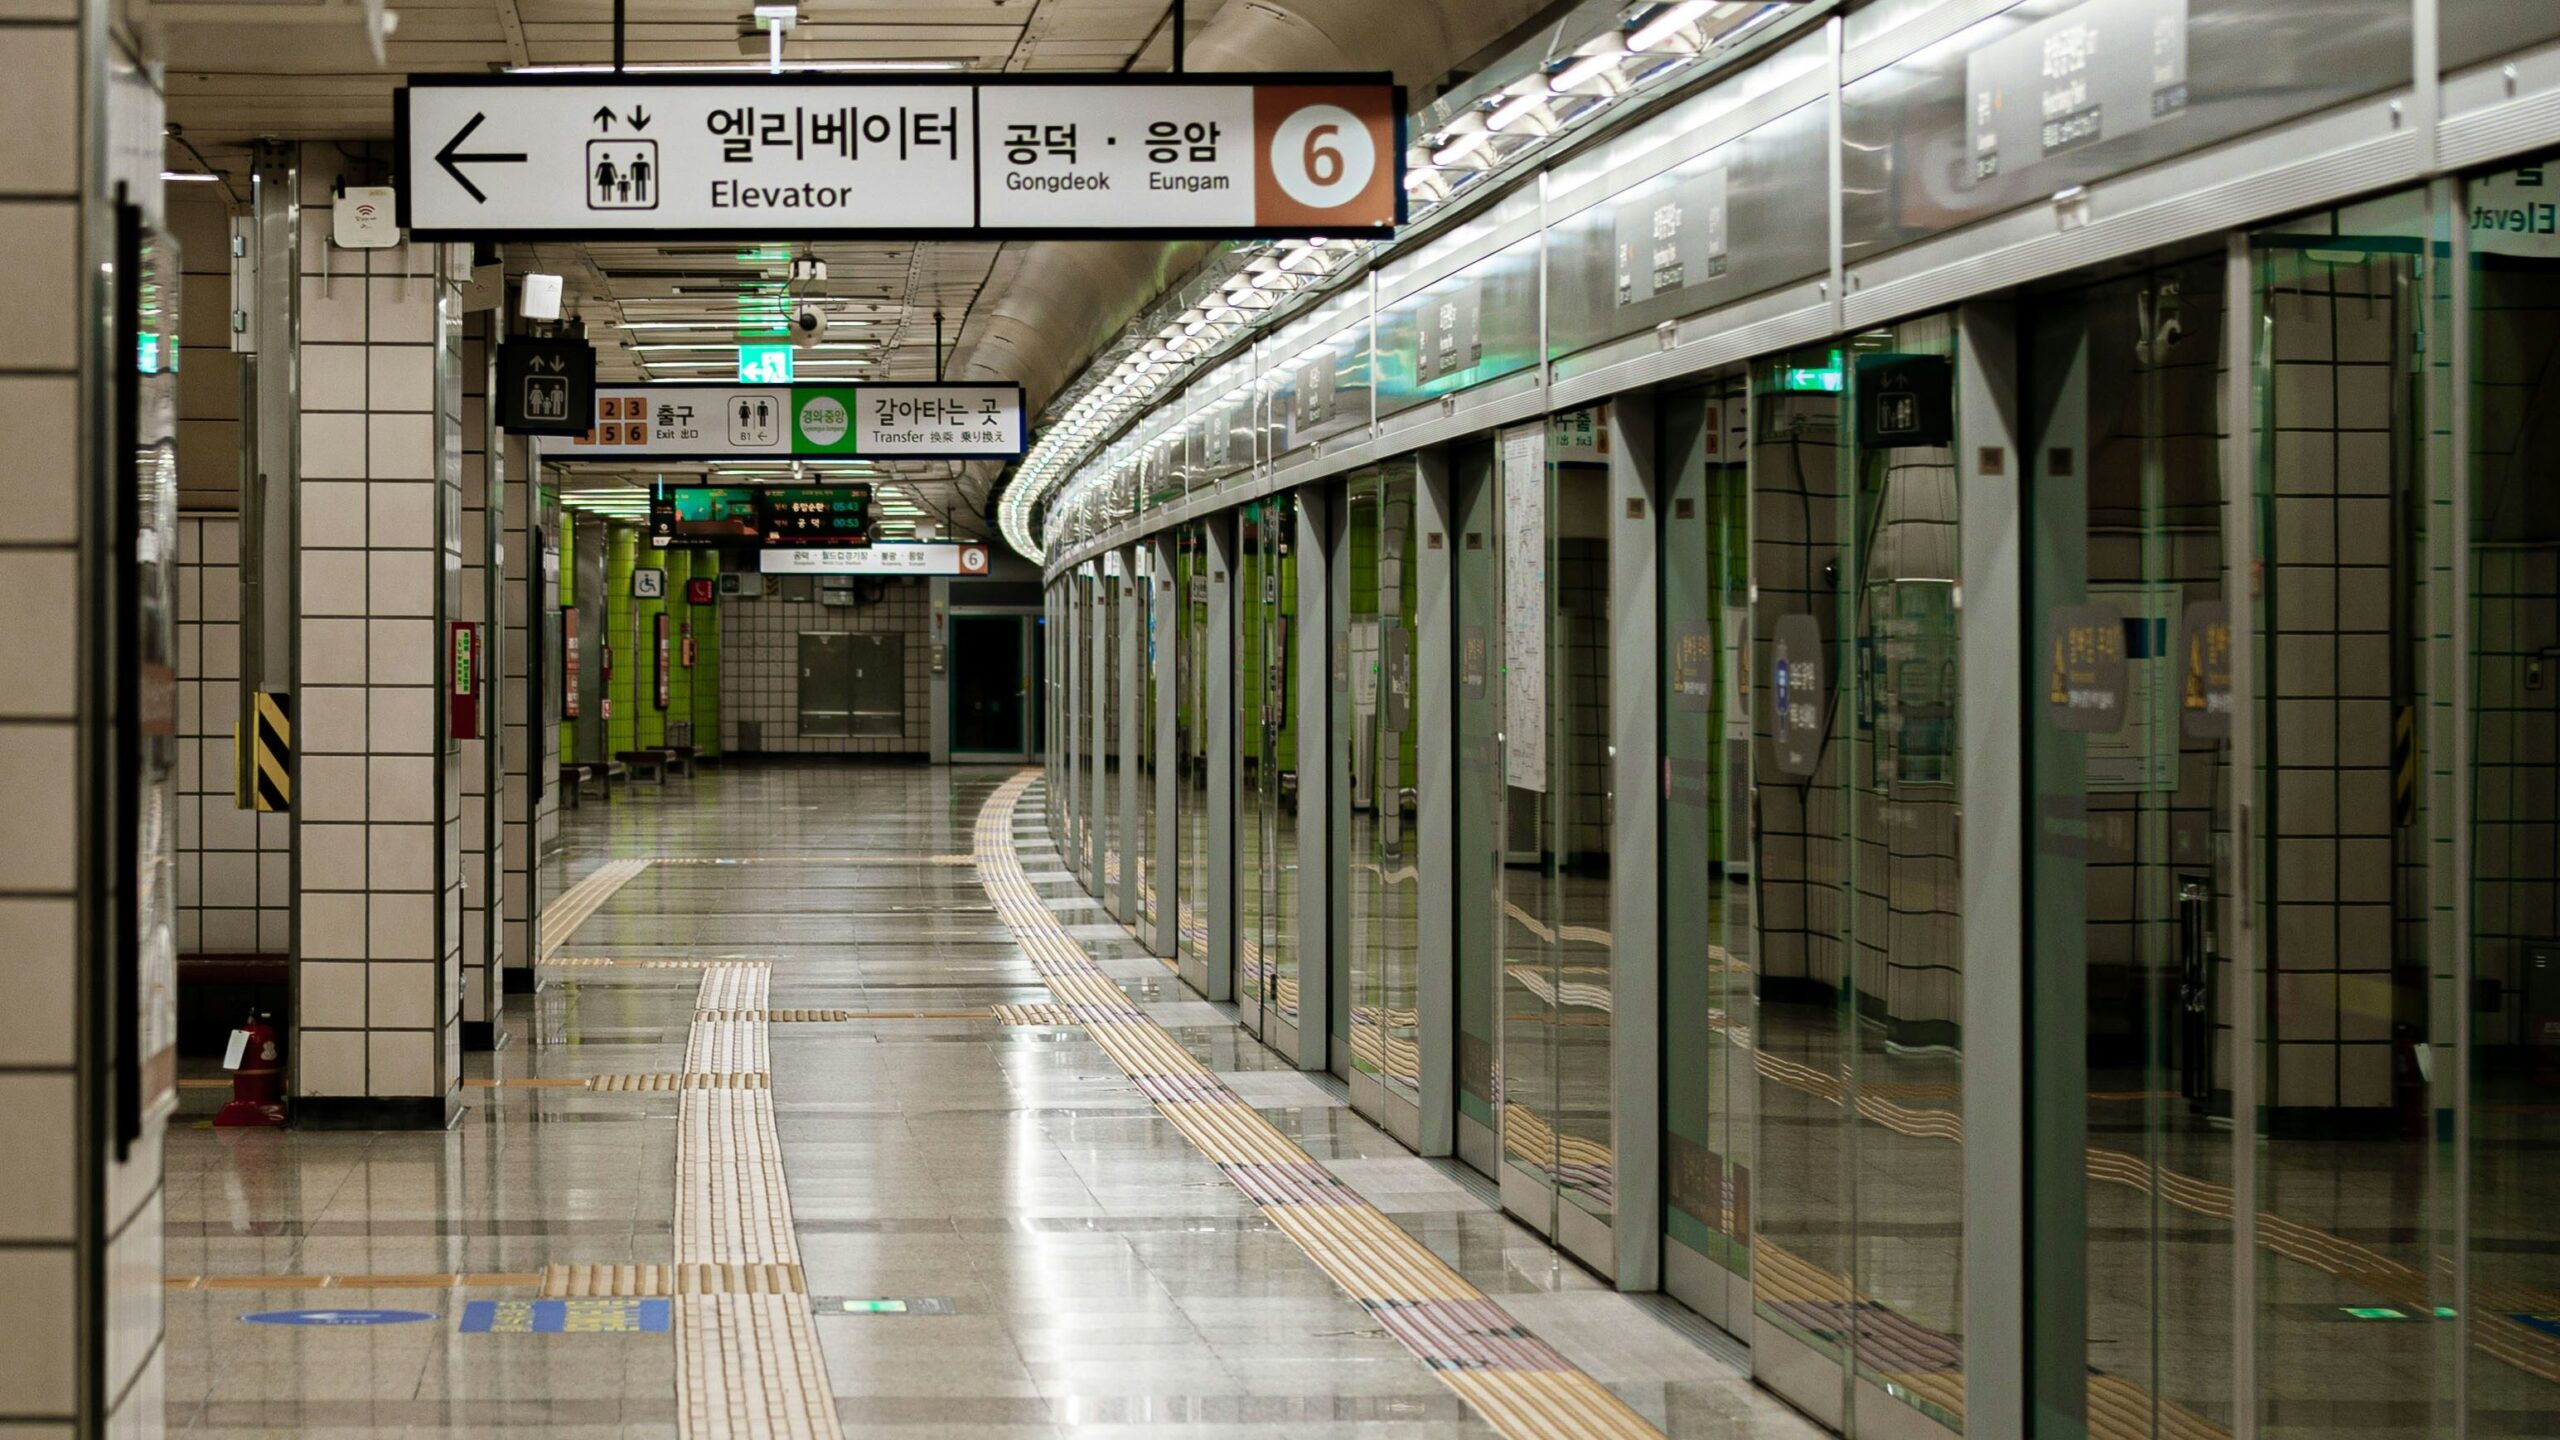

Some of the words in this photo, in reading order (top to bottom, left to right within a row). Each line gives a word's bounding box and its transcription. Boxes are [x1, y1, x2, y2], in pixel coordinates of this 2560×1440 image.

[707, 107, 957, 162] 엘리베이터
[1004, 123, 1077, 165] 공덕
[1145, 121, 1221, 163] 응암
[1303, 124, 1344, 187] 6
[1006, 172, 1110, 193] Gongdeok
[1149, 172, 1230, 192] Eungam
[712, 180, 853, 207] Elevator
[605, 402, 616, 416] 2
[630, 401, 641, 416] 3
[656, 405, 695, 426] 출구
[875, 398, 969, 426] 갈아타는
[978, 399, 1001, 425] 곳
[605, 426, 616, 441] 5
[630, 426, 642, 441] 6
[656, 430, 675, 440] Exit
[680, 429, 699, 440] 出口
[740, 432, 751, 441] B1
[873, 431, 924, 444] Transfer
[968, 553, 979, 567] 6
